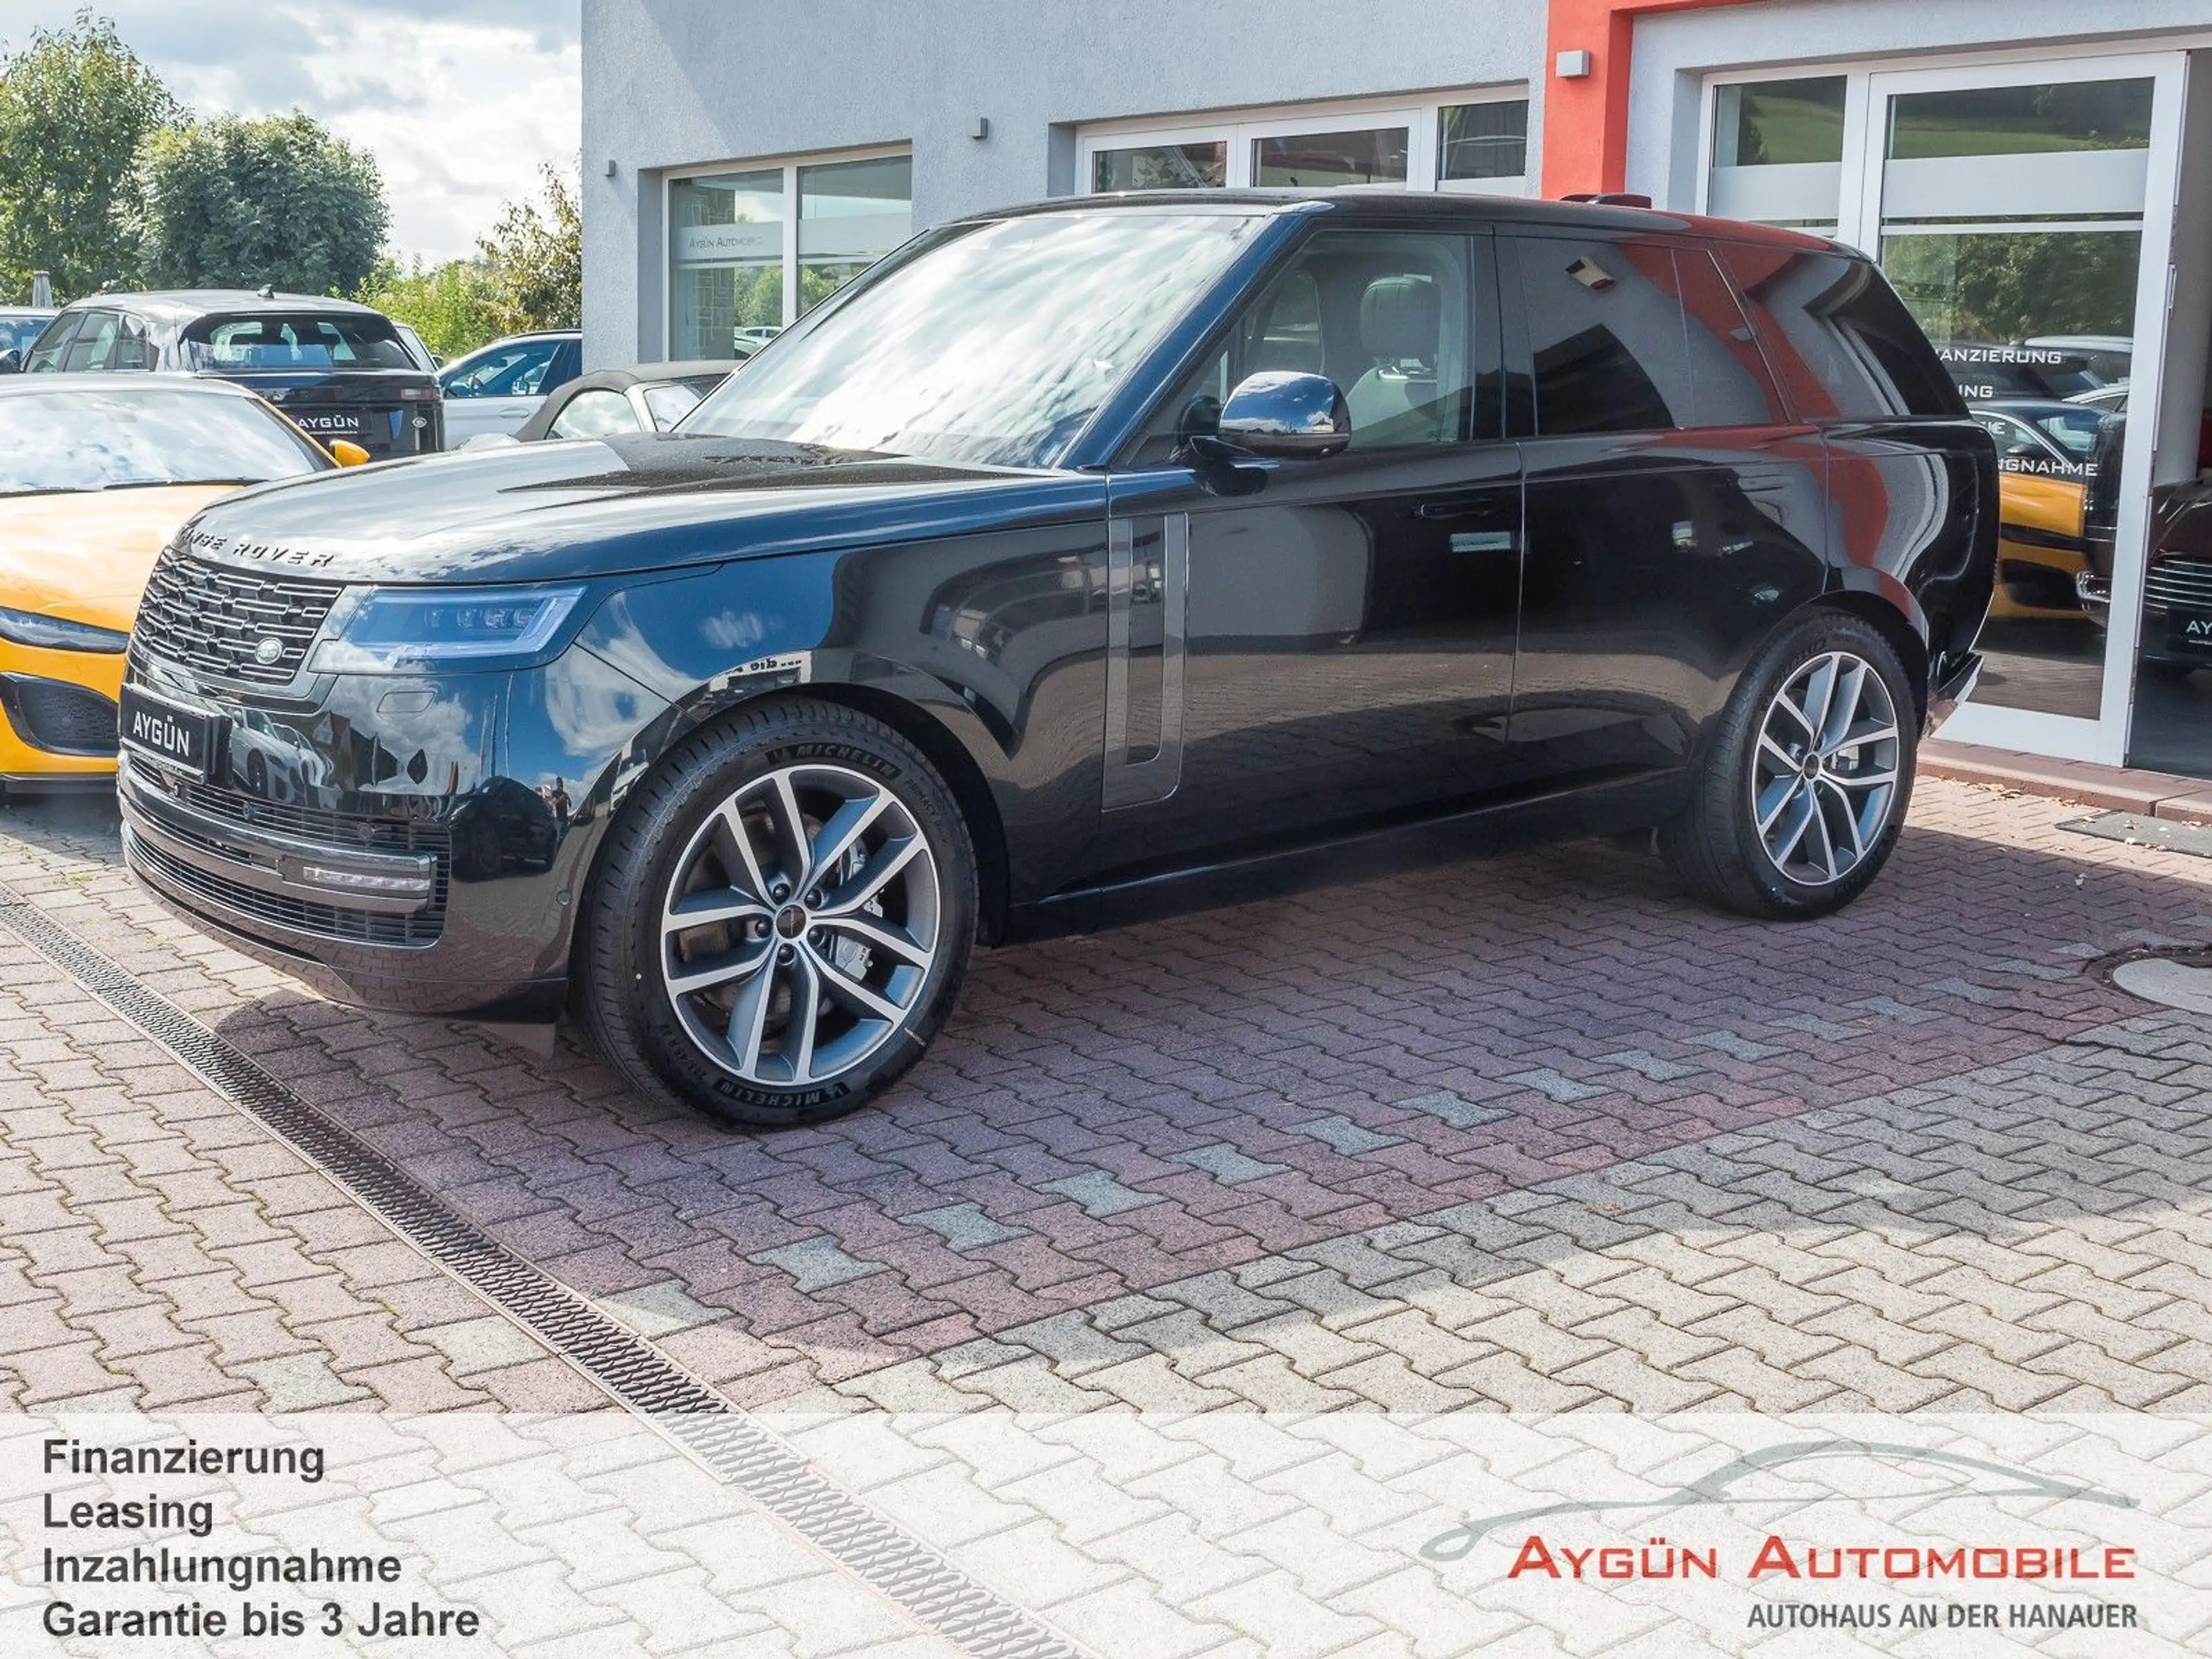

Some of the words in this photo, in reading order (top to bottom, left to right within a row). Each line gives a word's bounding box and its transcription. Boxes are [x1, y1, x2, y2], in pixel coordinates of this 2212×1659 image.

[298, 414, 359, 428] AYGÜN
[233, 543, 335, 567] ROVER
[132, 710, 190, 757] AYGÜN
[797, 744, 895, 777] MICHELIN
[720, 1083, 820, 1107] MICHELIN
